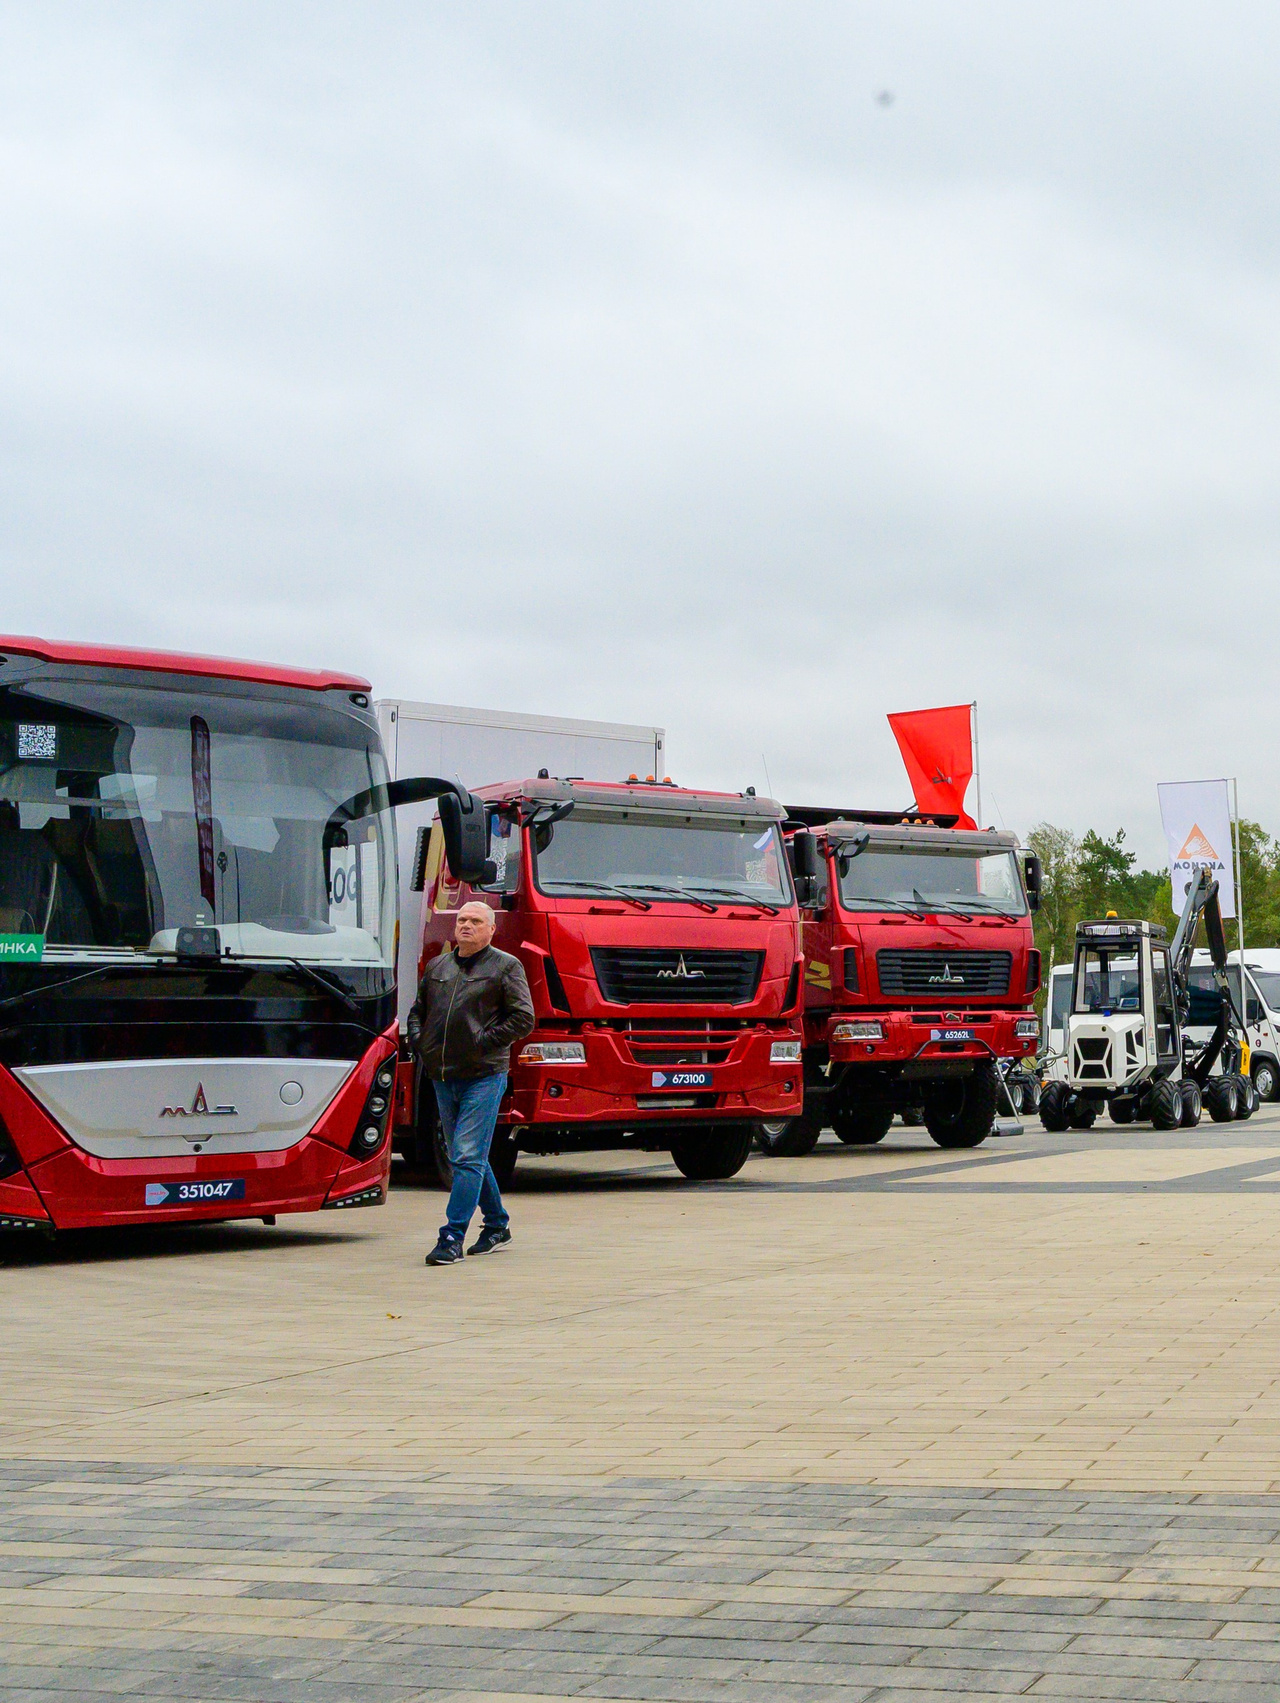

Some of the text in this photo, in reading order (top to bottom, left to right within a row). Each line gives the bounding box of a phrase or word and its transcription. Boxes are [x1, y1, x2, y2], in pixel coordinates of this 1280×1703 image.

[944, 1030, 970, 1039] 65262L
[671, 1073, 706, 1084] 673100
[178, 1182, 234, 1200] 351047
